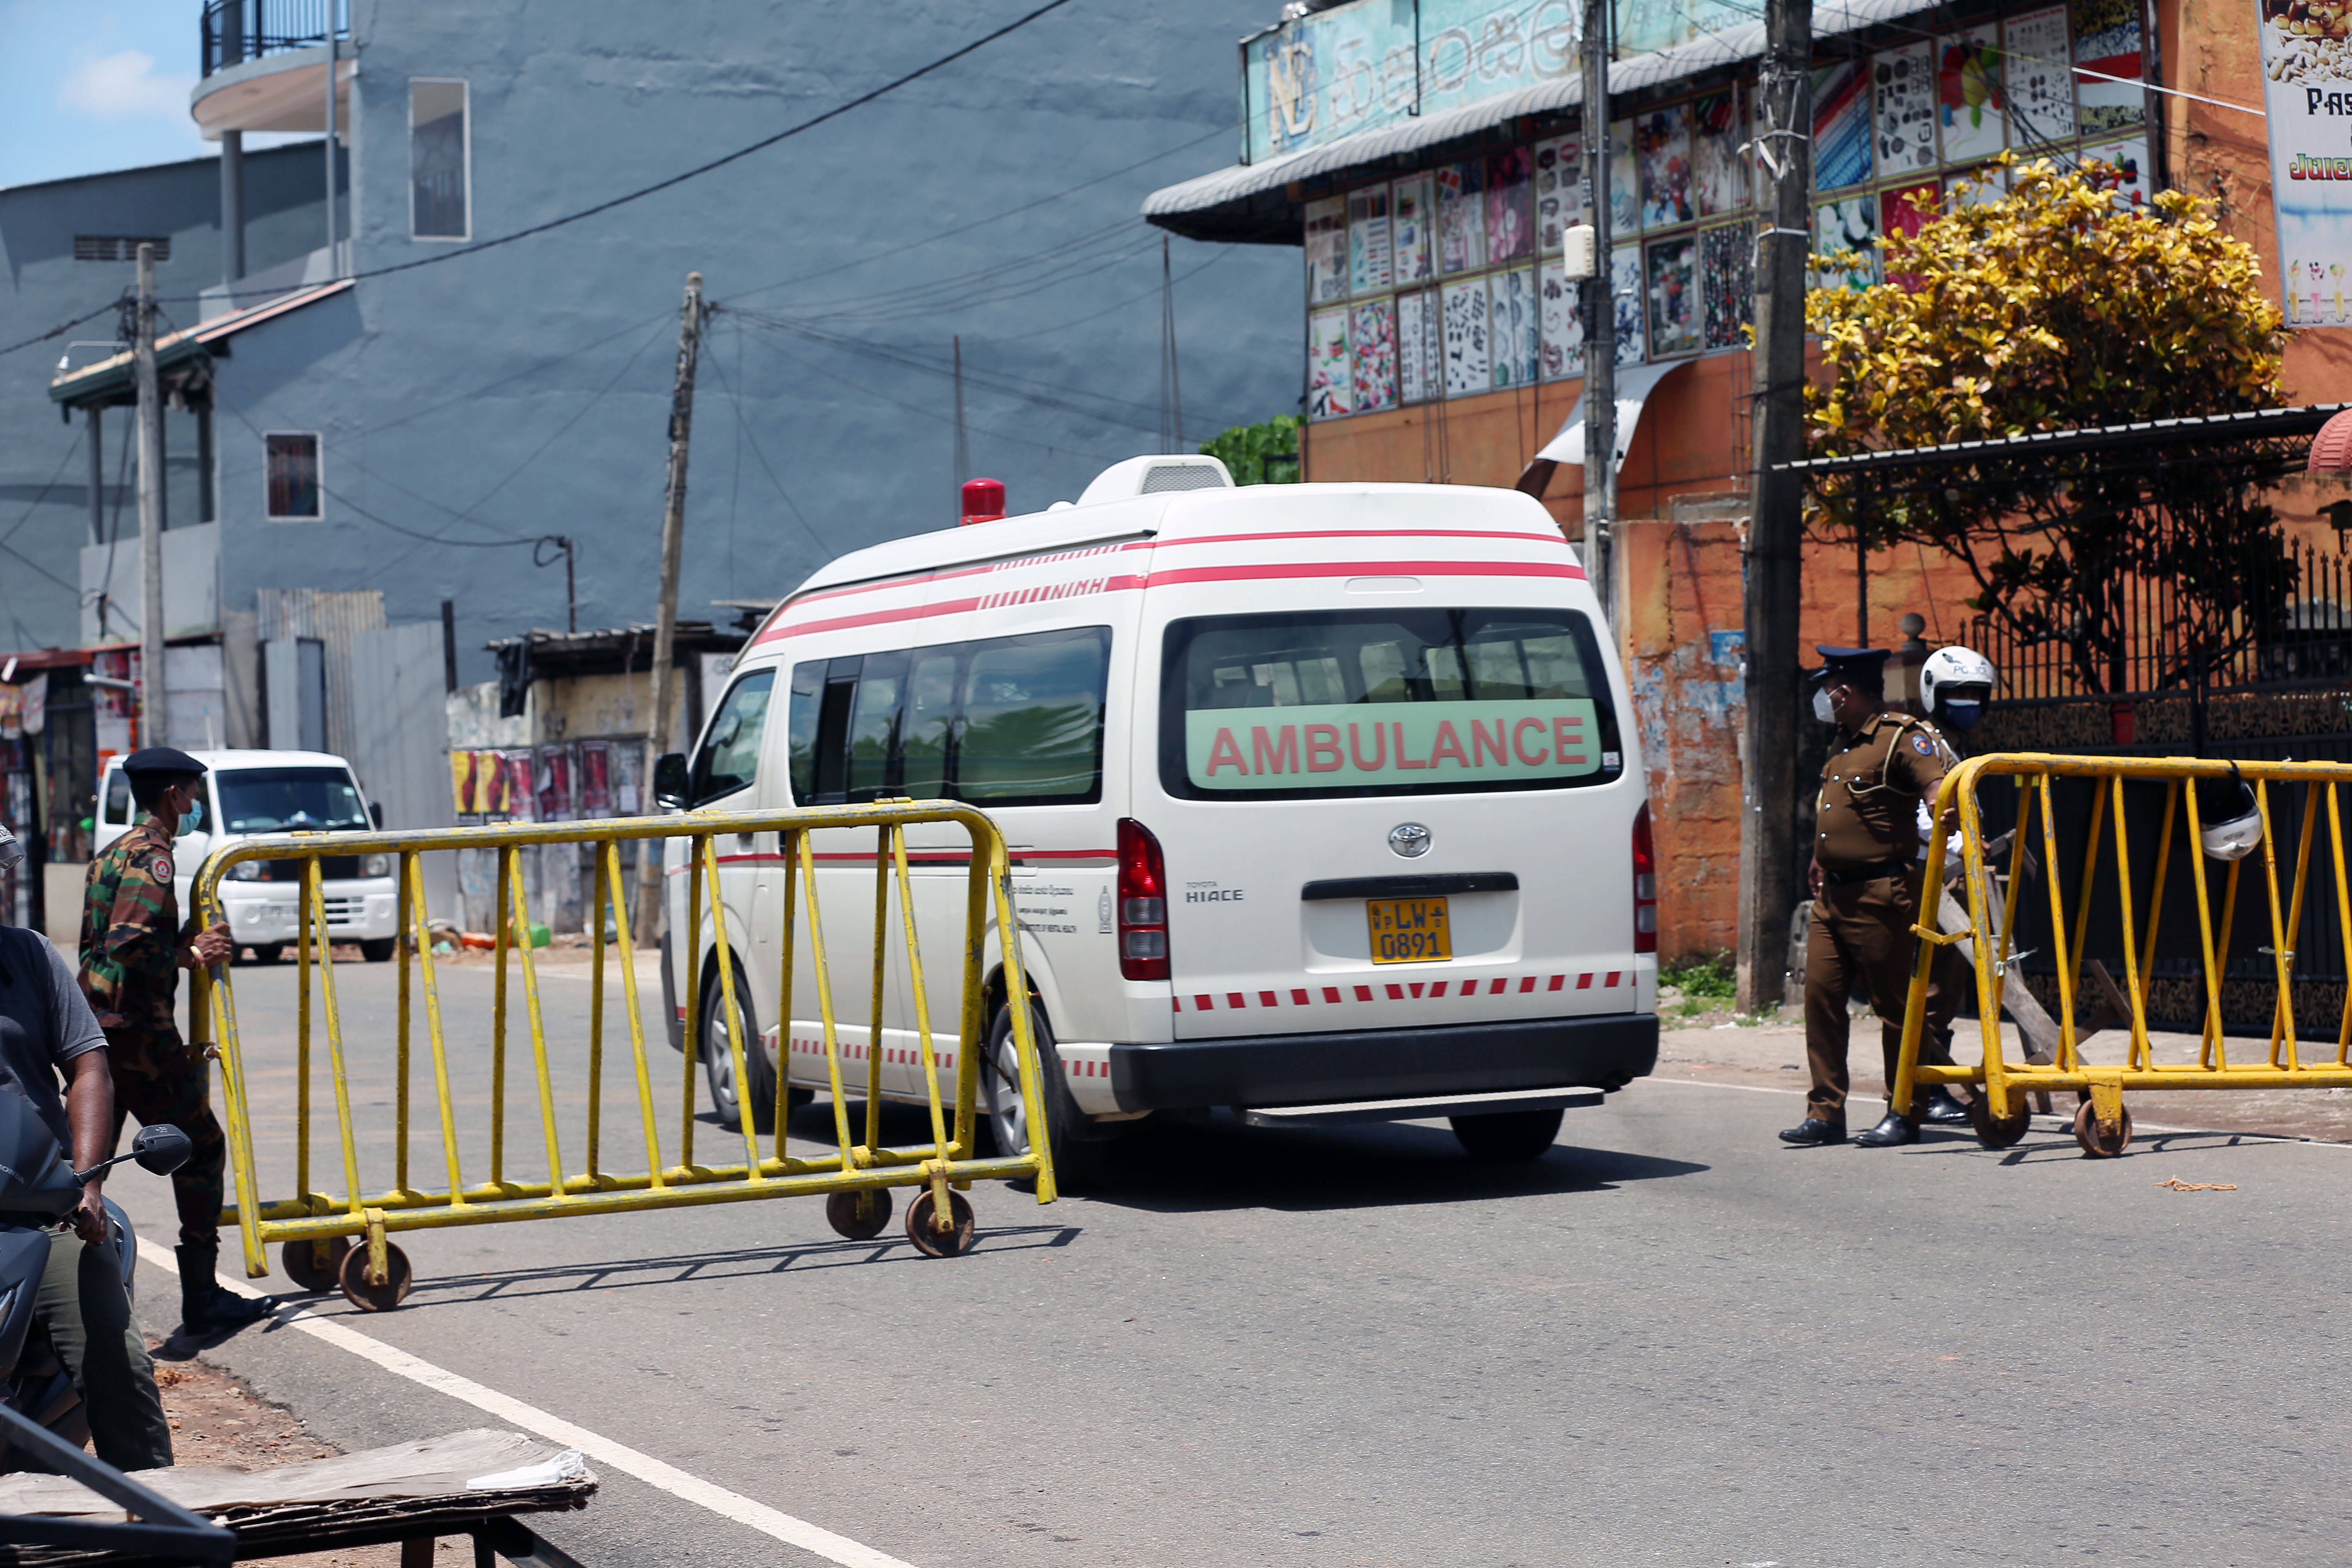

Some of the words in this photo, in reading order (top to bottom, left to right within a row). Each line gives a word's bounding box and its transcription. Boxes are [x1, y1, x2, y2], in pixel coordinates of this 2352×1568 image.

[1051, 578, 1104, 599] NIMH
[1206, 716, 1587, 776] AMBULANCE
[1186, 889, 1243, 903] HIACE
[1380, 931, 1442, 960] 0891
